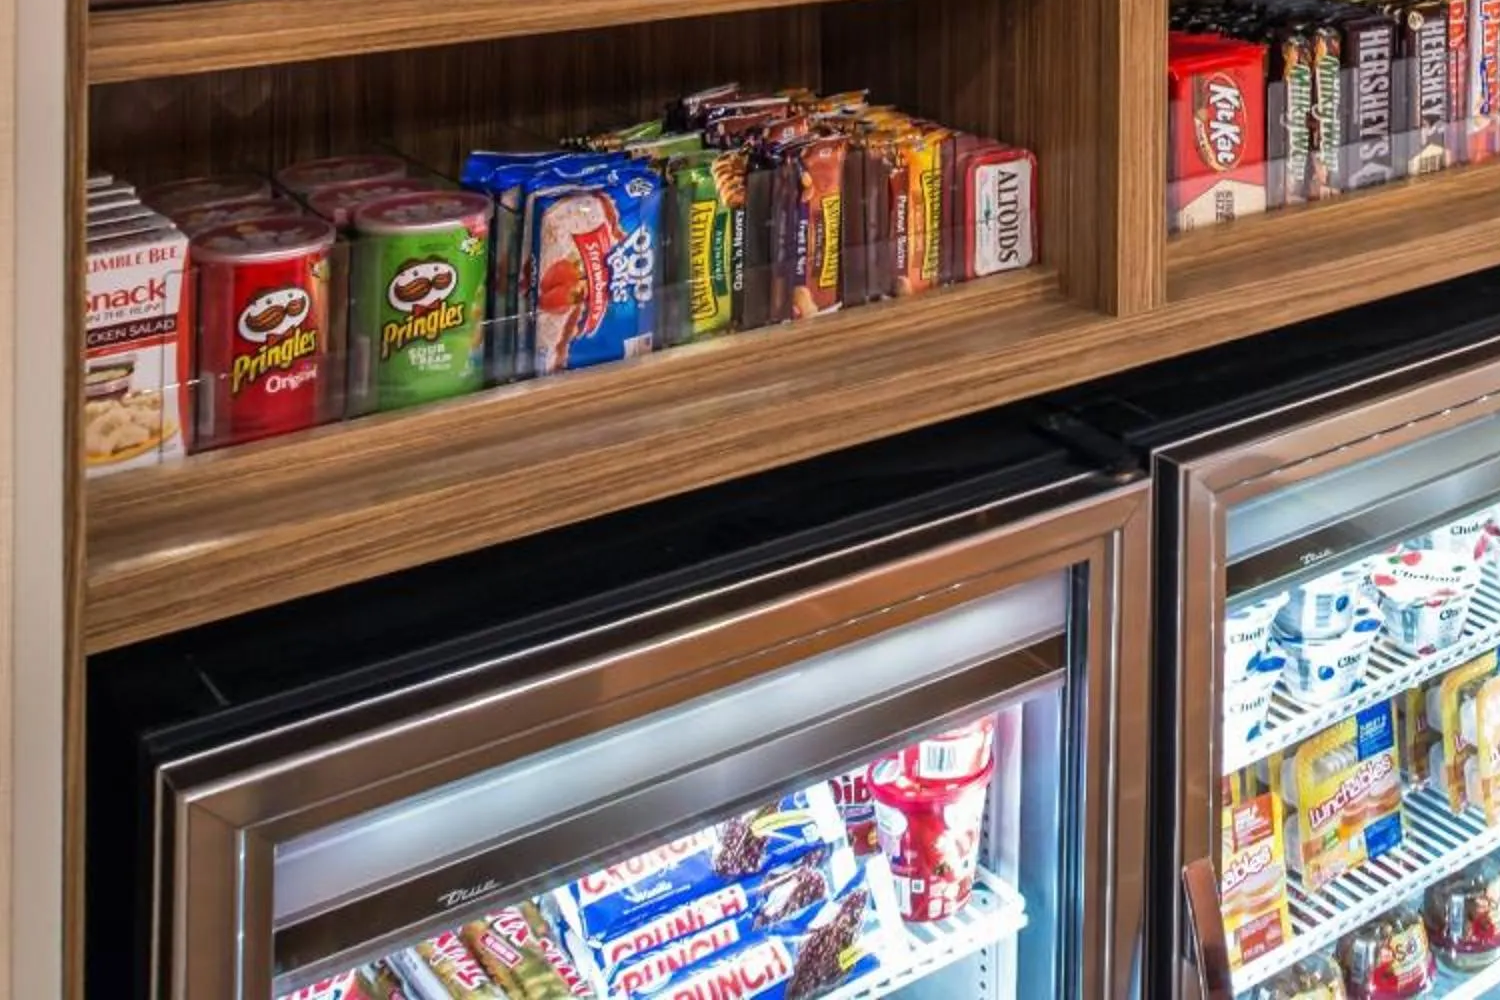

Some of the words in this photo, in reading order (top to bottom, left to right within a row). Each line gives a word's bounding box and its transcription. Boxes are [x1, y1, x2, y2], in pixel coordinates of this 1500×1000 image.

[997, 170, 1020, 264] ALTOIDS
[232, 328, 318, 393] Pringles
[381, 302, 464, 361] Pringles
[829, 775, 872, 806] Dib
[1309, 752, 1393, 828] Lunchables
[1224, 844, 1273, 893] ables
[673, 944, 788, 1000] RUNCH
